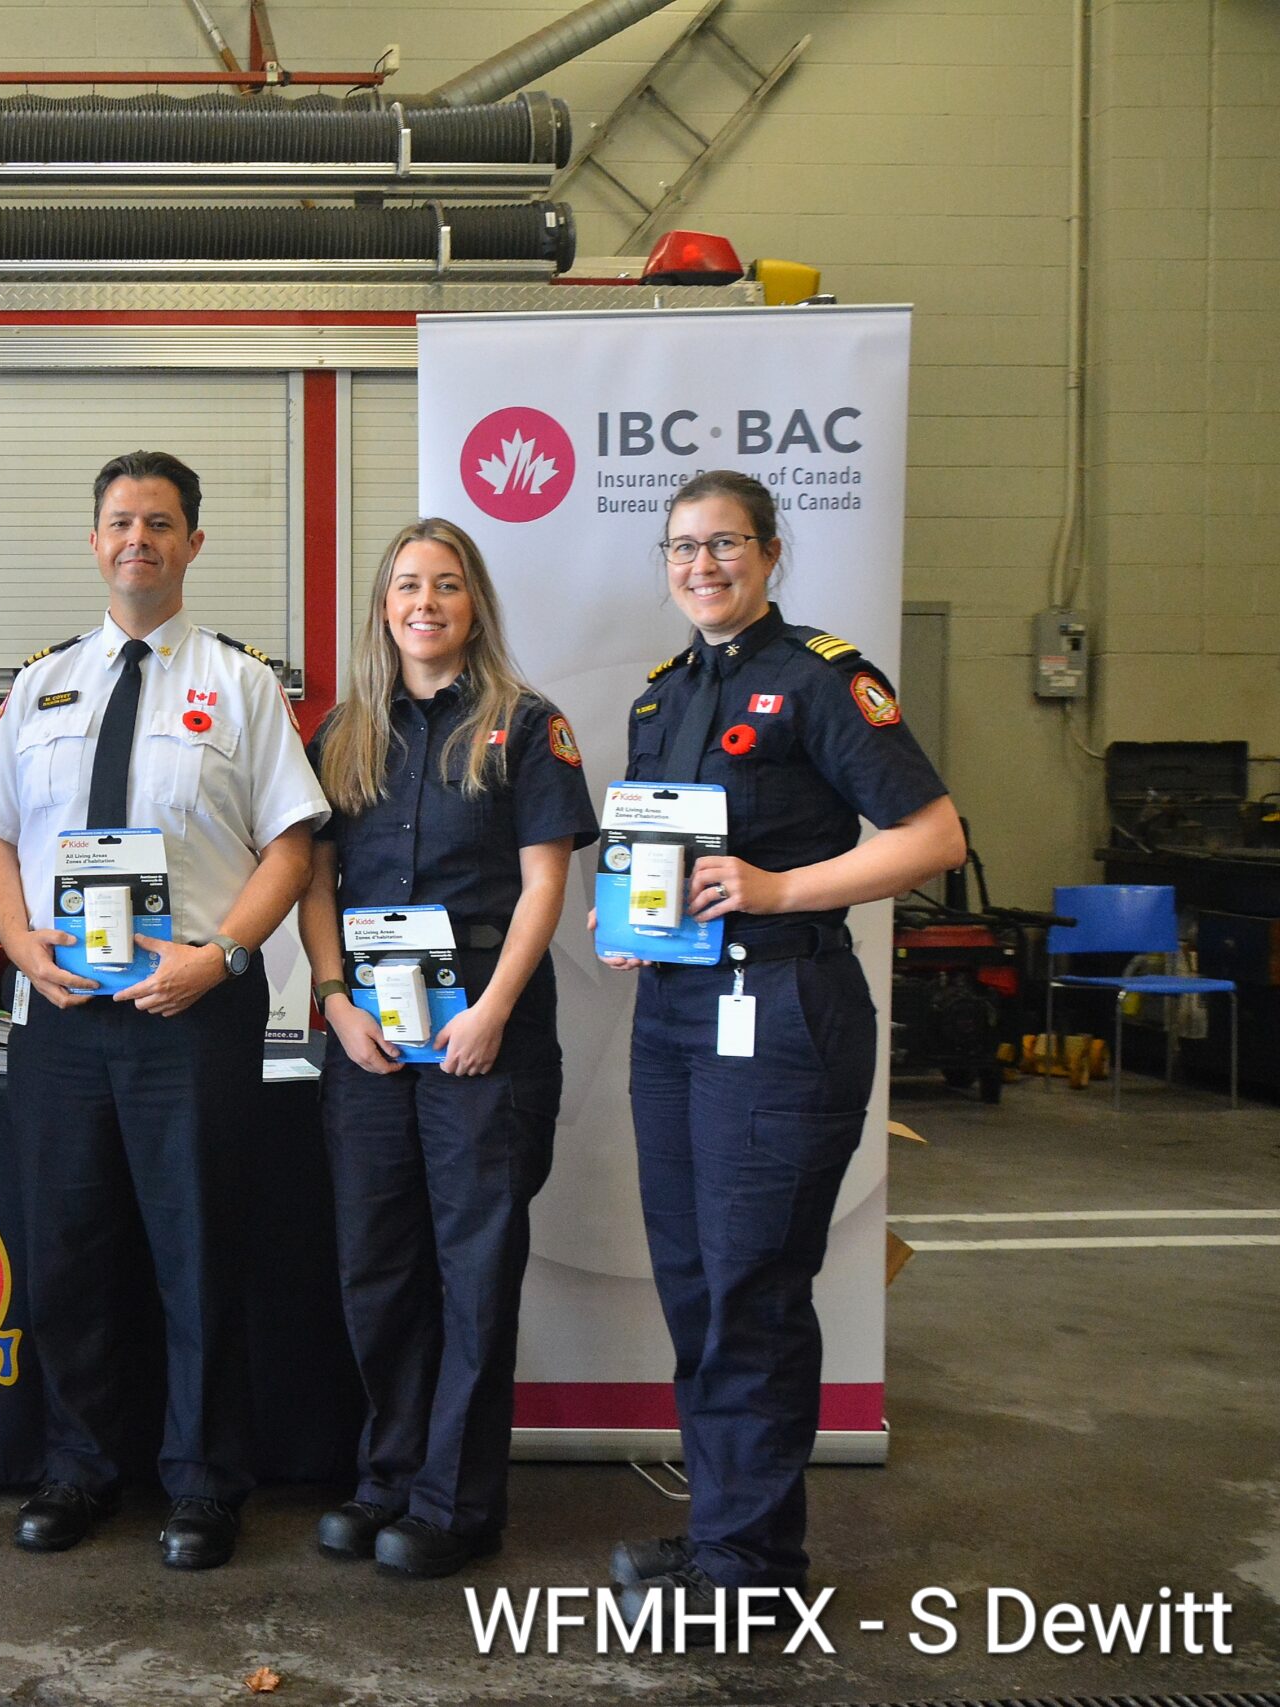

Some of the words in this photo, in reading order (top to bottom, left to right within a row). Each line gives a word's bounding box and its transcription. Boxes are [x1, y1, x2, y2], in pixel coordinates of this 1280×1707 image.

[597, 409, 699, 457] IBC
[737, 406, 864, 455] BAC
[597, 470, 688, 488] Insurance
[769, 467, 787, 486] of
[791, 466, 861, 485] Canada
[597, 495, 658, 513] Bureau
[797, 492, 862, 510] Canada
[69, 840, 89, 848] Kidde
